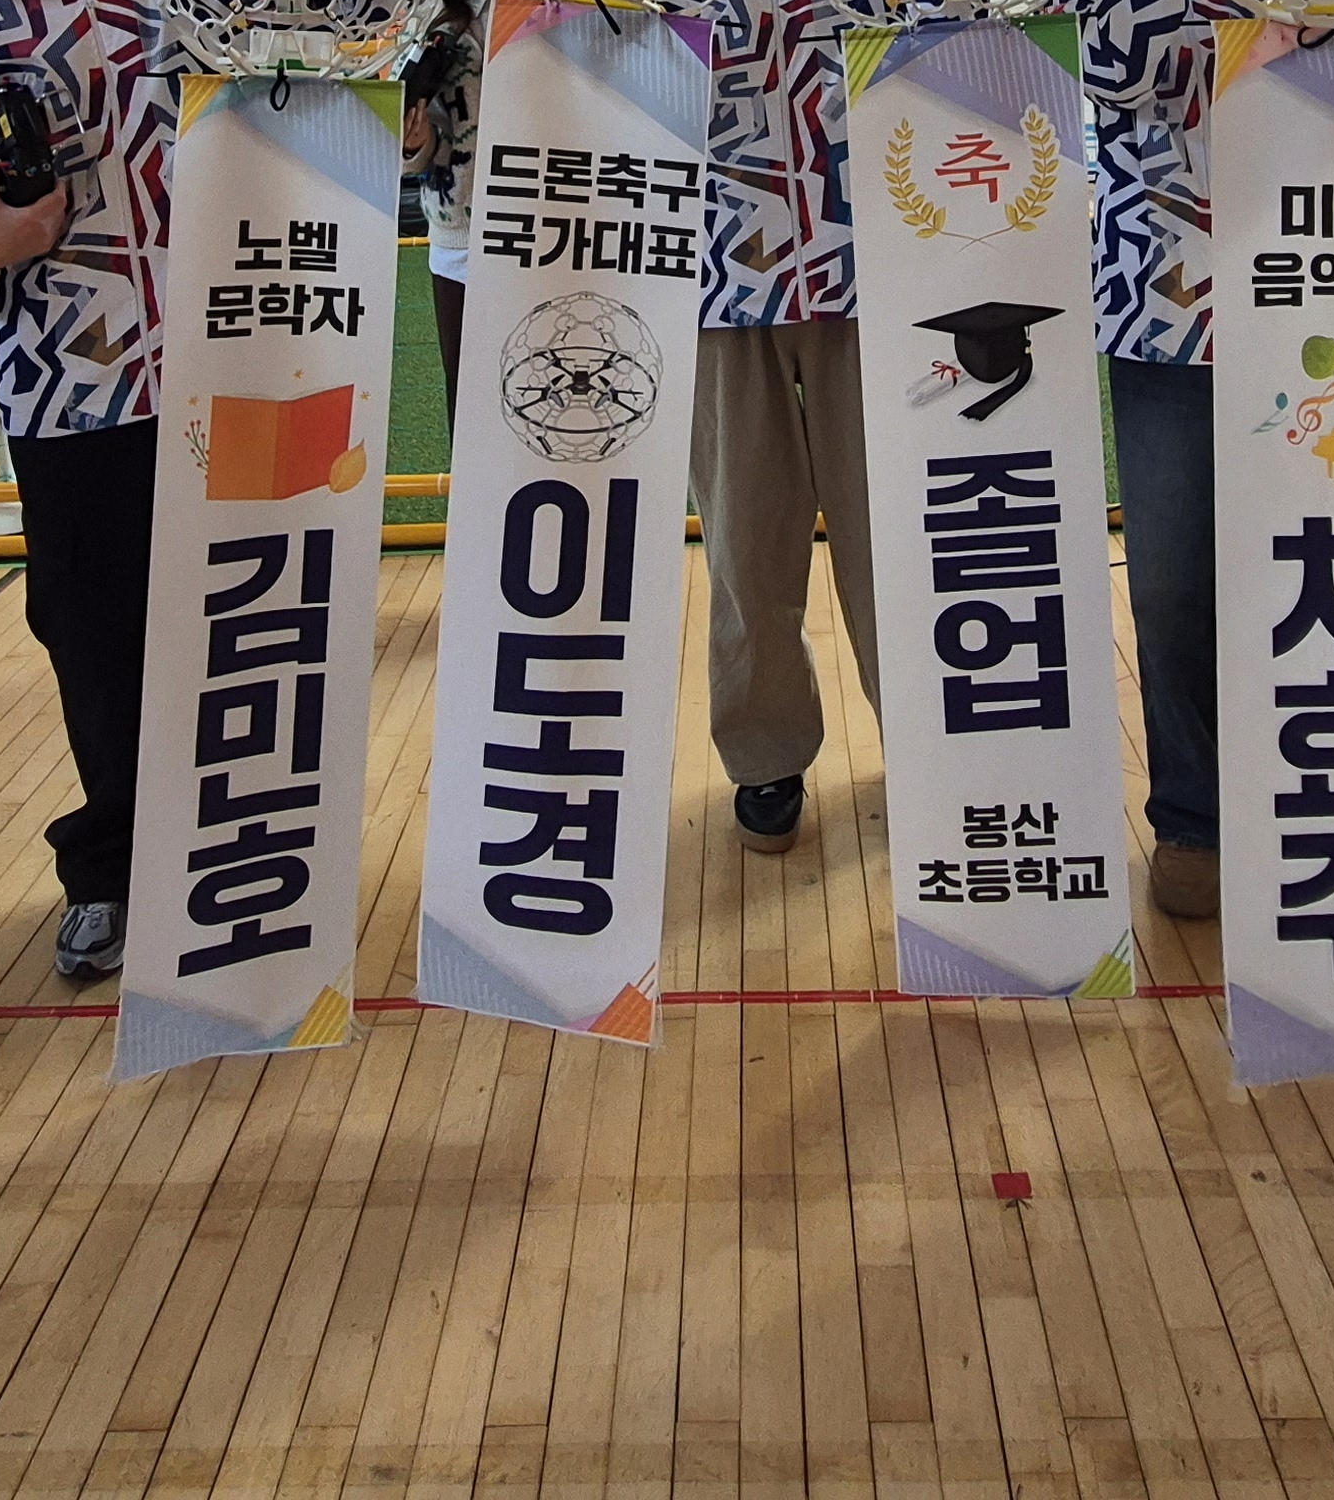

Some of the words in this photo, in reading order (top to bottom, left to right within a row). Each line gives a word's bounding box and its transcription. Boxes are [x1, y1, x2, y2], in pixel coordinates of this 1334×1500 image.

[487, 145, 701, 213] 드론축구
[935, 133, 1010, 203] 축
[234, 220, 338, 273] 노벨
[483, 211, 697, 279] 국가대표
[205, 283, 365, 339] 문학자
[924, 450, 1071, 734] 졸업
[478, 478, 639, 936] 이도경
[177, 529, 334, 978] 김민호
[963, 802, 1058, 849] 봉산
[919, 856, 1109, 903] 초등학교
